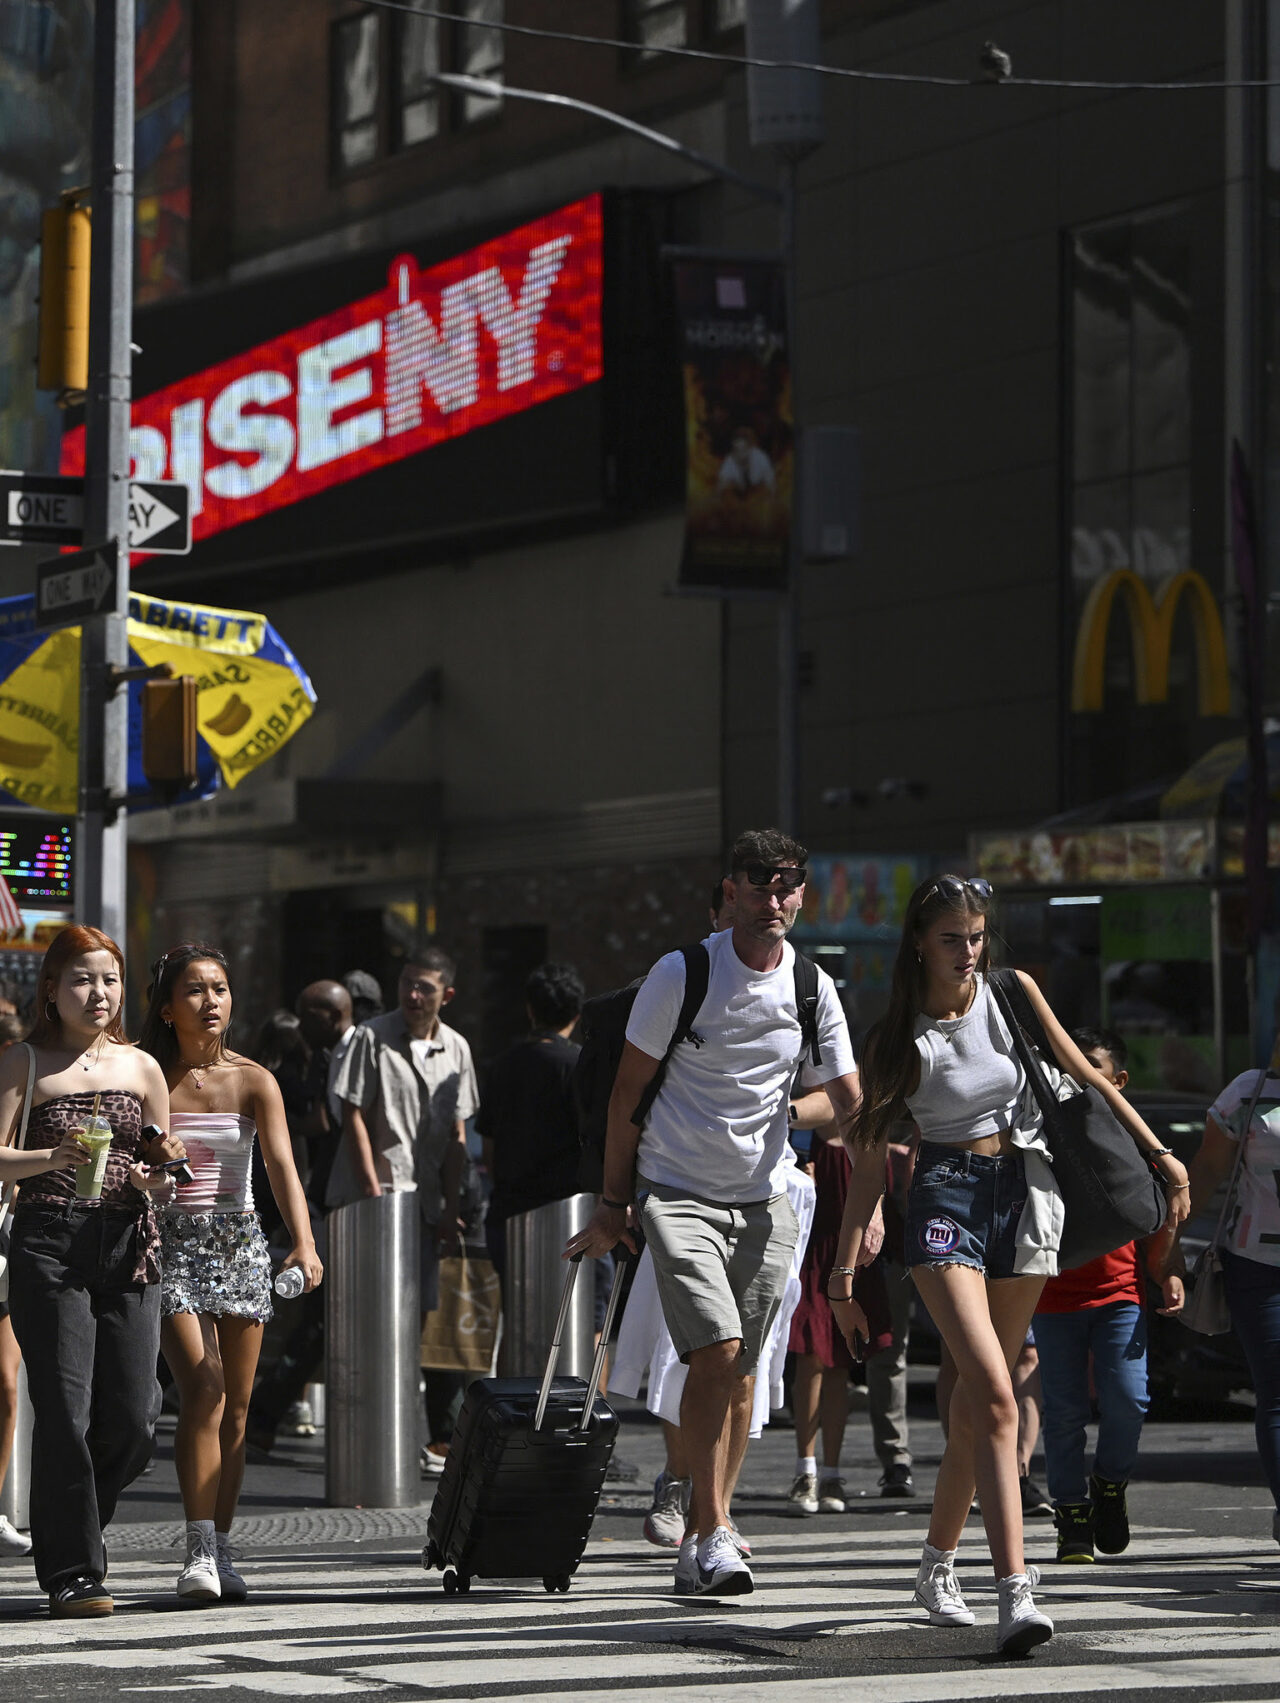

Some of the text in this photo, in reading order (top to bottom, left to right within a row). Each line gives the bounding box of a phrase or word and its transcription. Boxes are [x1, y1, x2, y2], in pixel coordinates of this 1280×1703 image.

[17, 496, 156, 528] ONE AY
[46, 575, 72, 605] ONE
[129, 598, 255, 643] ABRETT
